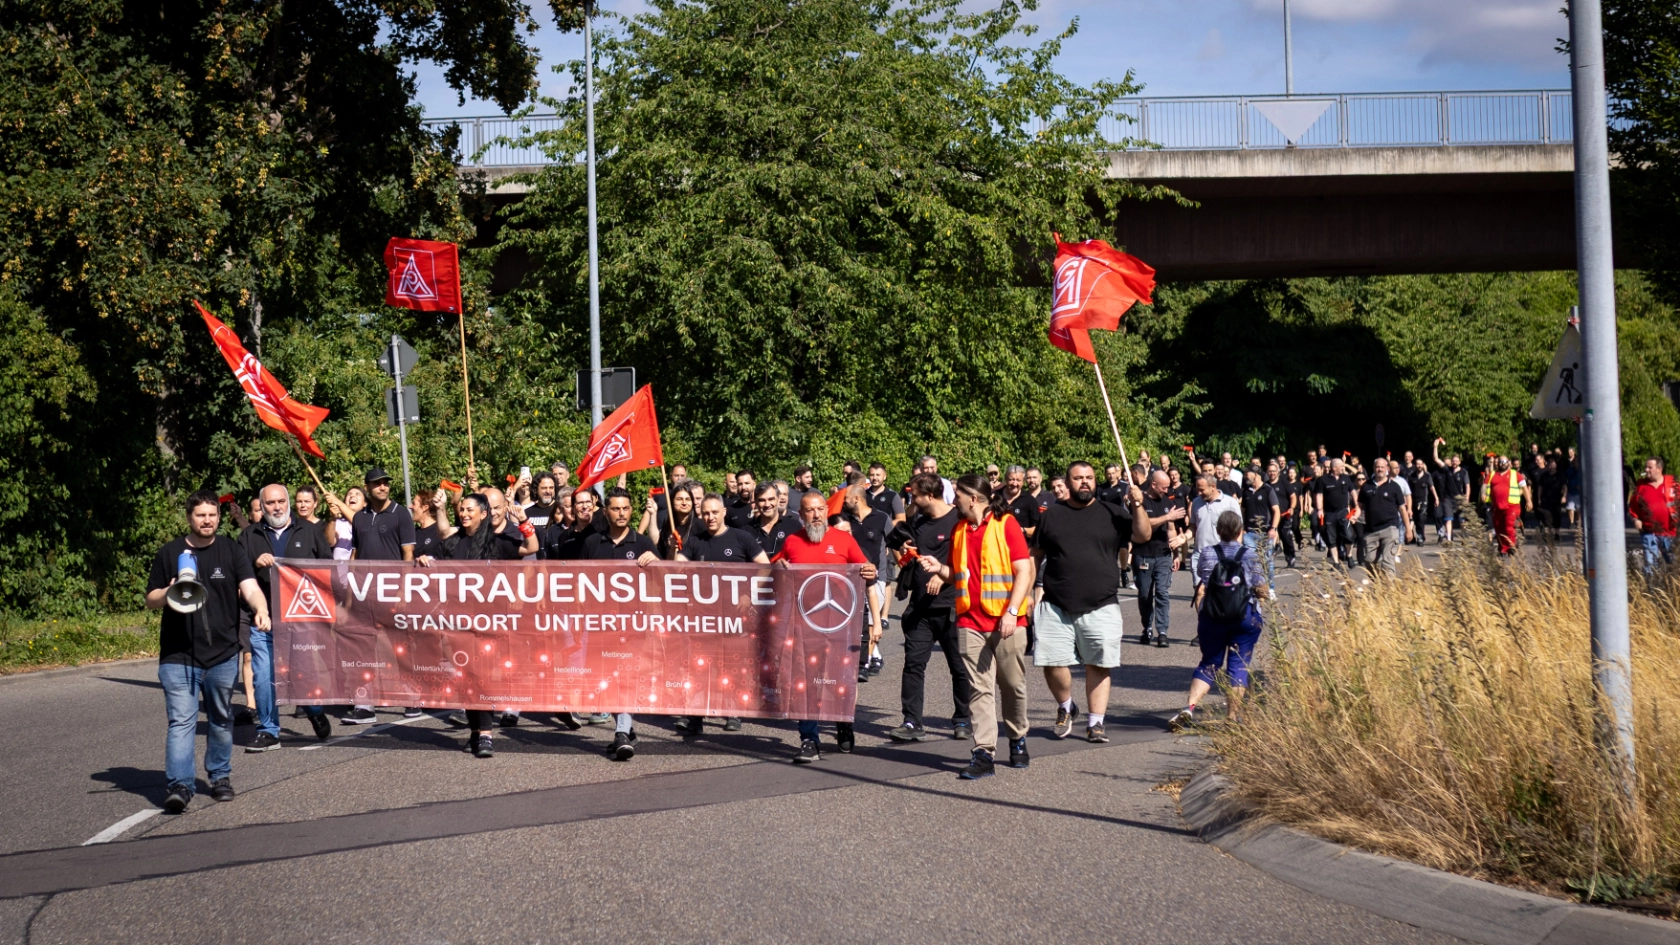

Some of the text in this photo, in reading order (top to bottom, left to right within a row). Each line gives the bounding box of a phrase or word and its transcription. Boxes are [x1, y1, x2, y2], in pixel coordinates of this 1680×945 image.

[347, 572, 776, 606] VERTRAUENSLEUTE
[394, 611, 744, 634] STANDORT UNTERTÜRKHEIM
[292, 643, 326, 651] Möglingen
[601, 651, 633, 659] Mettingen
